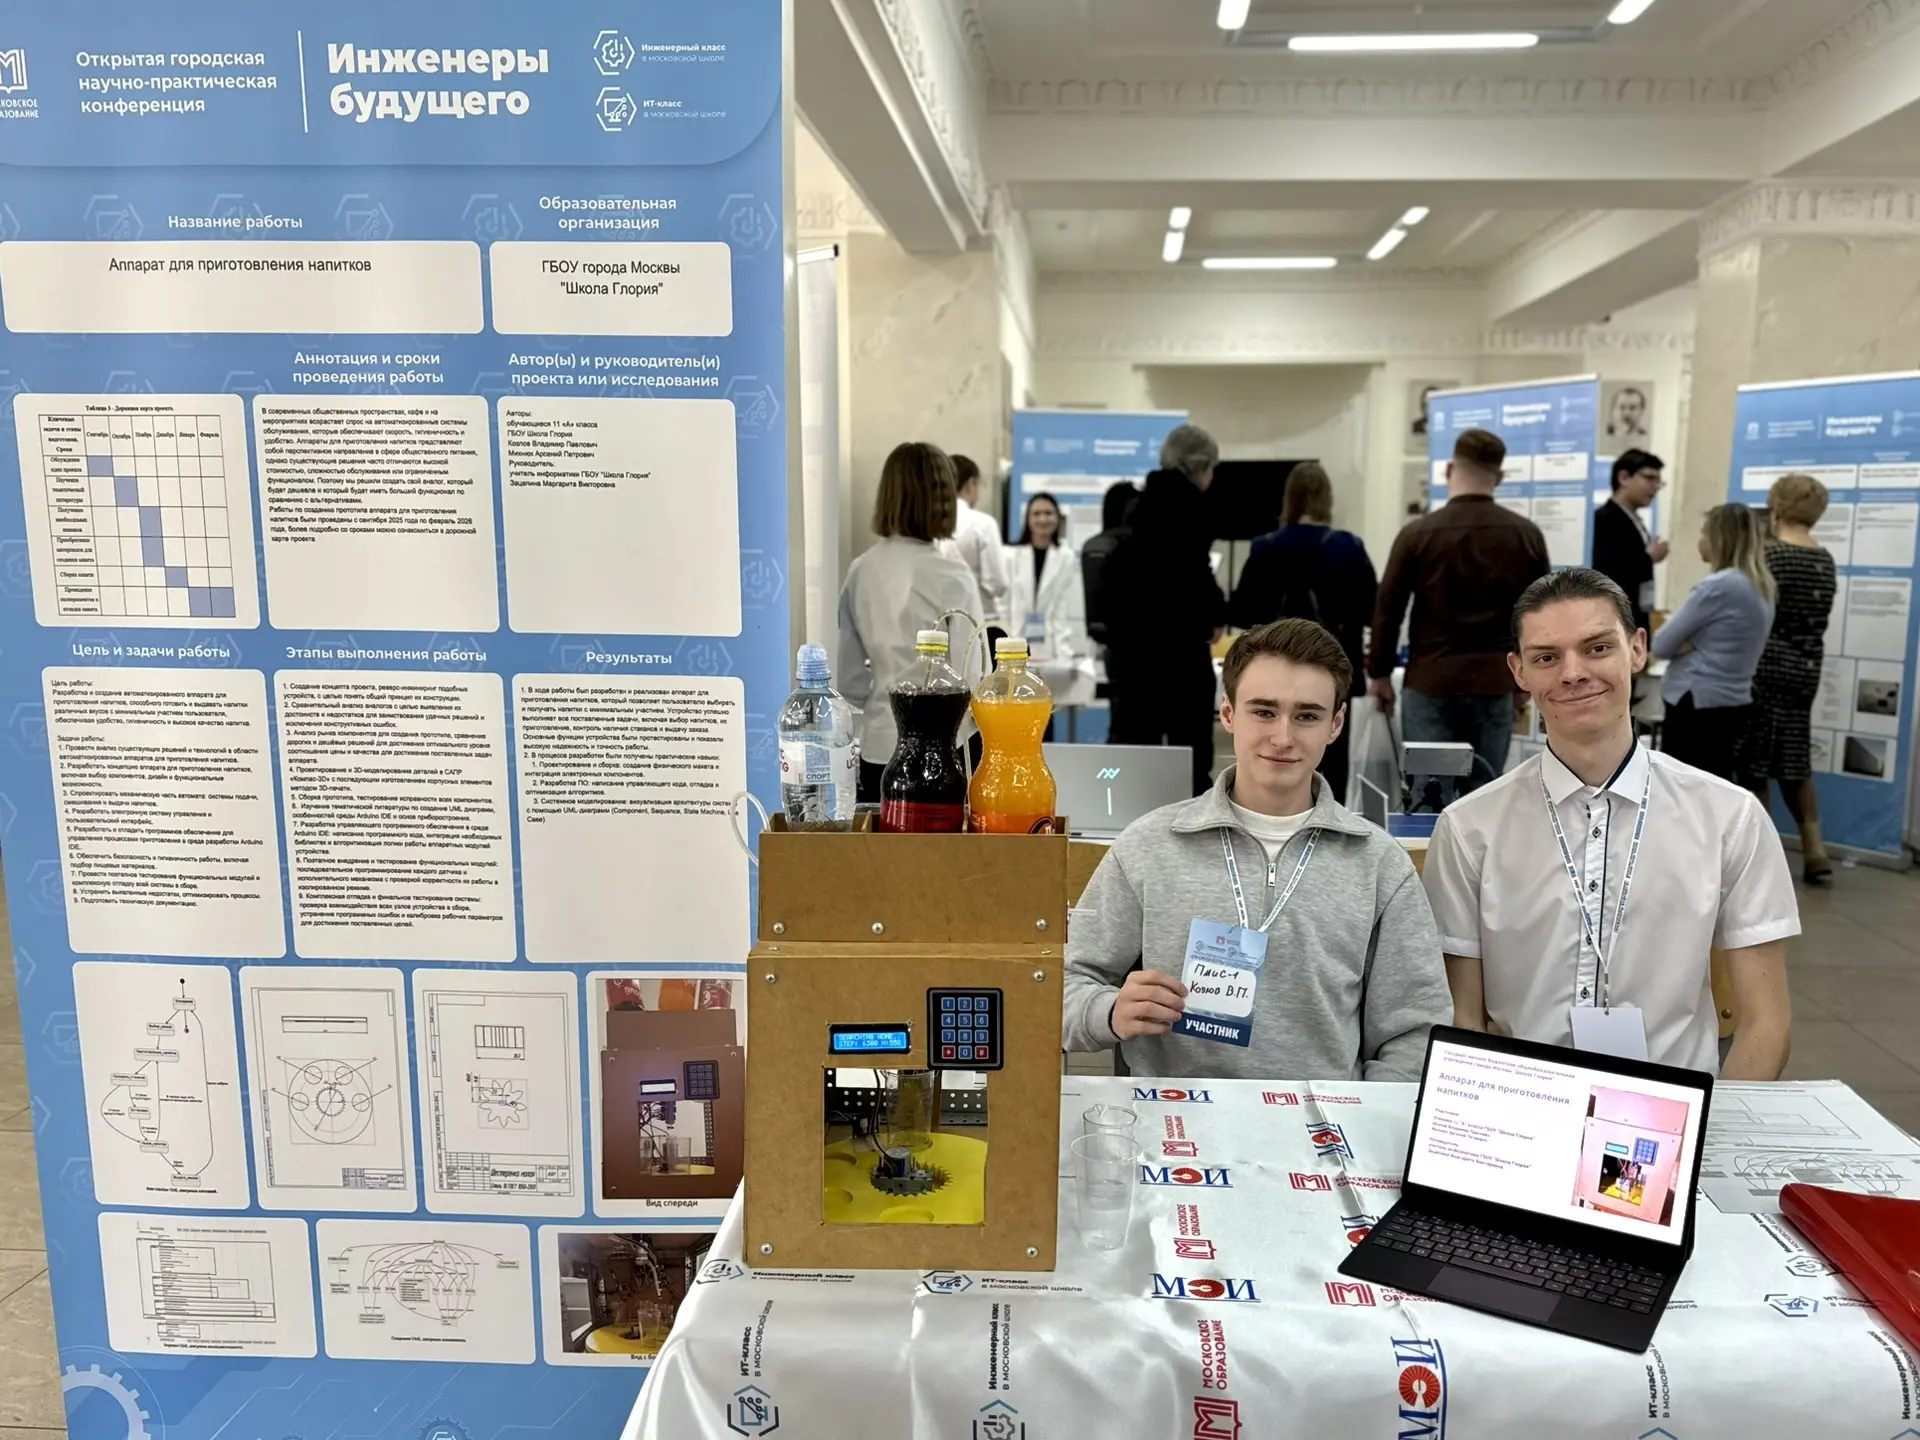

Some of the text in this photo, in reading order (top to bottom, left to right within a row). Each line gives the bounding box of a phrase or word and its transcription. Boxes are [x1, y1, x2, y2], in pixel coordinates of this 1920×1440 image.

[641, 43, 699, 52] Инженерный
[76, 52, 264, 69] Открытая городская
[328, 44, 548, 80] Инженеры
[79, 76, 276, 92] научно-практическая
[0, 98, 38, 107] КОВСКОЕ
[81, 98, 205, 116] конференция
[330, 83, 529, 122] будущего
[643, 99, 681, 107] ИТ-класс
[539, 195, 676, 211] Образовательная
[168, 214, 302, 230] Название работы
[558, 218, 659, 231] организация
[109, 258, 371, 273] Аппарат для приготовления напитков
[542, 260, 680, 276] ГБОУ города Москвы
[560, 281, 663, 297] "Школа Глория"
[294, 352, 439, 367] Аннотация и сроки
[508, 353, 720, 370] Автор(ы) и руководитель(и)
[293, 370, 443, 386] проведения работы
[512, 374, 718, 387] проекта или исследования
[507, 429, 525, 437] ГБОУ
[581, 470, 599, 478] ГБОУ
[72, 644, 230, 659] Цель и задачи работы
[286, 646, 486, 662] Этапы выполнения работы
[586, 651, 672, 665] Результаты
[1185, 1019, 1240, 1040] УЧАСТНИК
[1131, 1088, 1212, 1102] МЭИ
[1436, 1086, 1480, 1101] напитков
[1439, 1072, 1570, 1105] Аппарат для приготовления
[1139, 1165, 1231, 1186] МЭИ
[646, 1199, 662, 1207] Вид
[1149, 1273, 1257, 1300] МЭИ
[754, 1314, 767, 1368] московской
[988, 1303, 1000, 1390] Инженерный класс
[741, 1326, 752, 1376] ИТ-класс
[1197, 1320, 1213, 1388] МОСКОВСКОЕ
[1211, 1320, 1227, 1390] ОБРАЗОВАНИЕ
[1645, 1364, 1657, 1418] ИТ-класс
[1884, 1347, 1910, 1420] Инженерный
